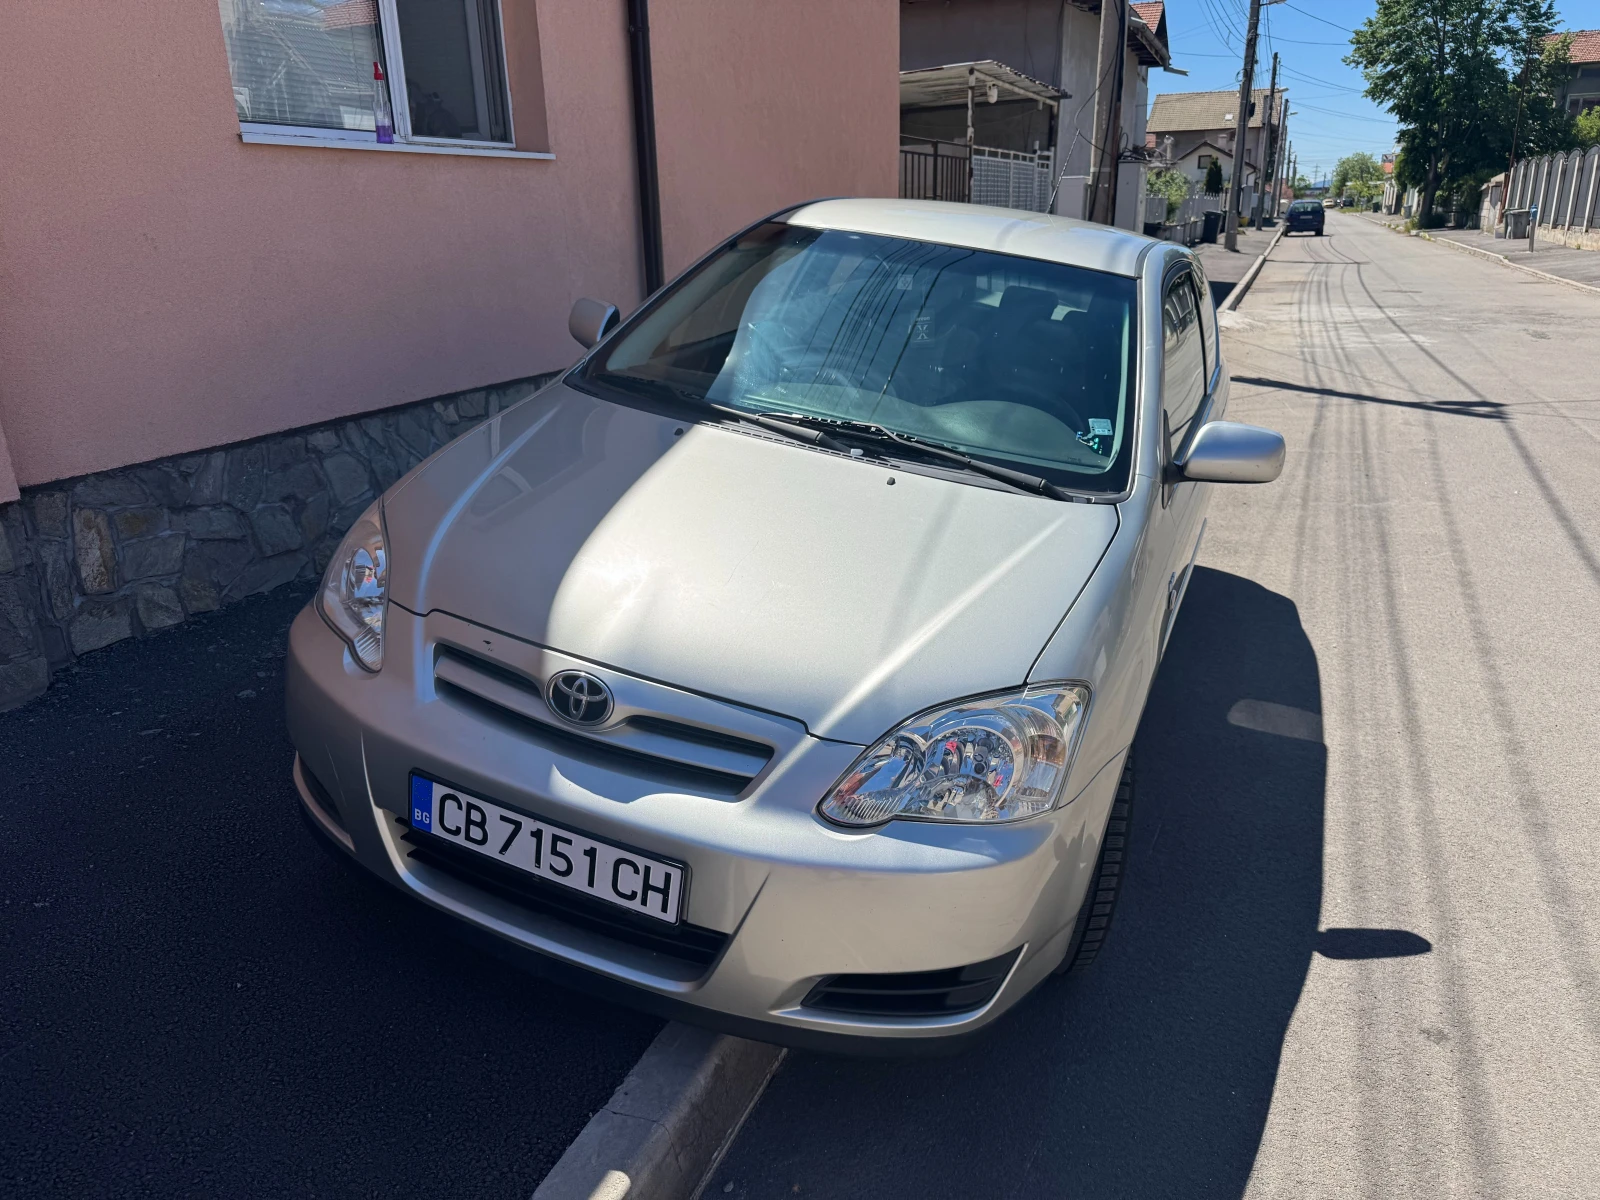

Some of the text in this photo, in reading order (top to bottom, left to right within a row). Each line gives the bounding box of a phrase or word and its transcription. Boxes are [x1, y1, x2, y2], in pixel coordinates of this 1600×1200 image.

[414, 808, 430, 824] BG
[438, 792, 672, 914] CB 7151 CH
